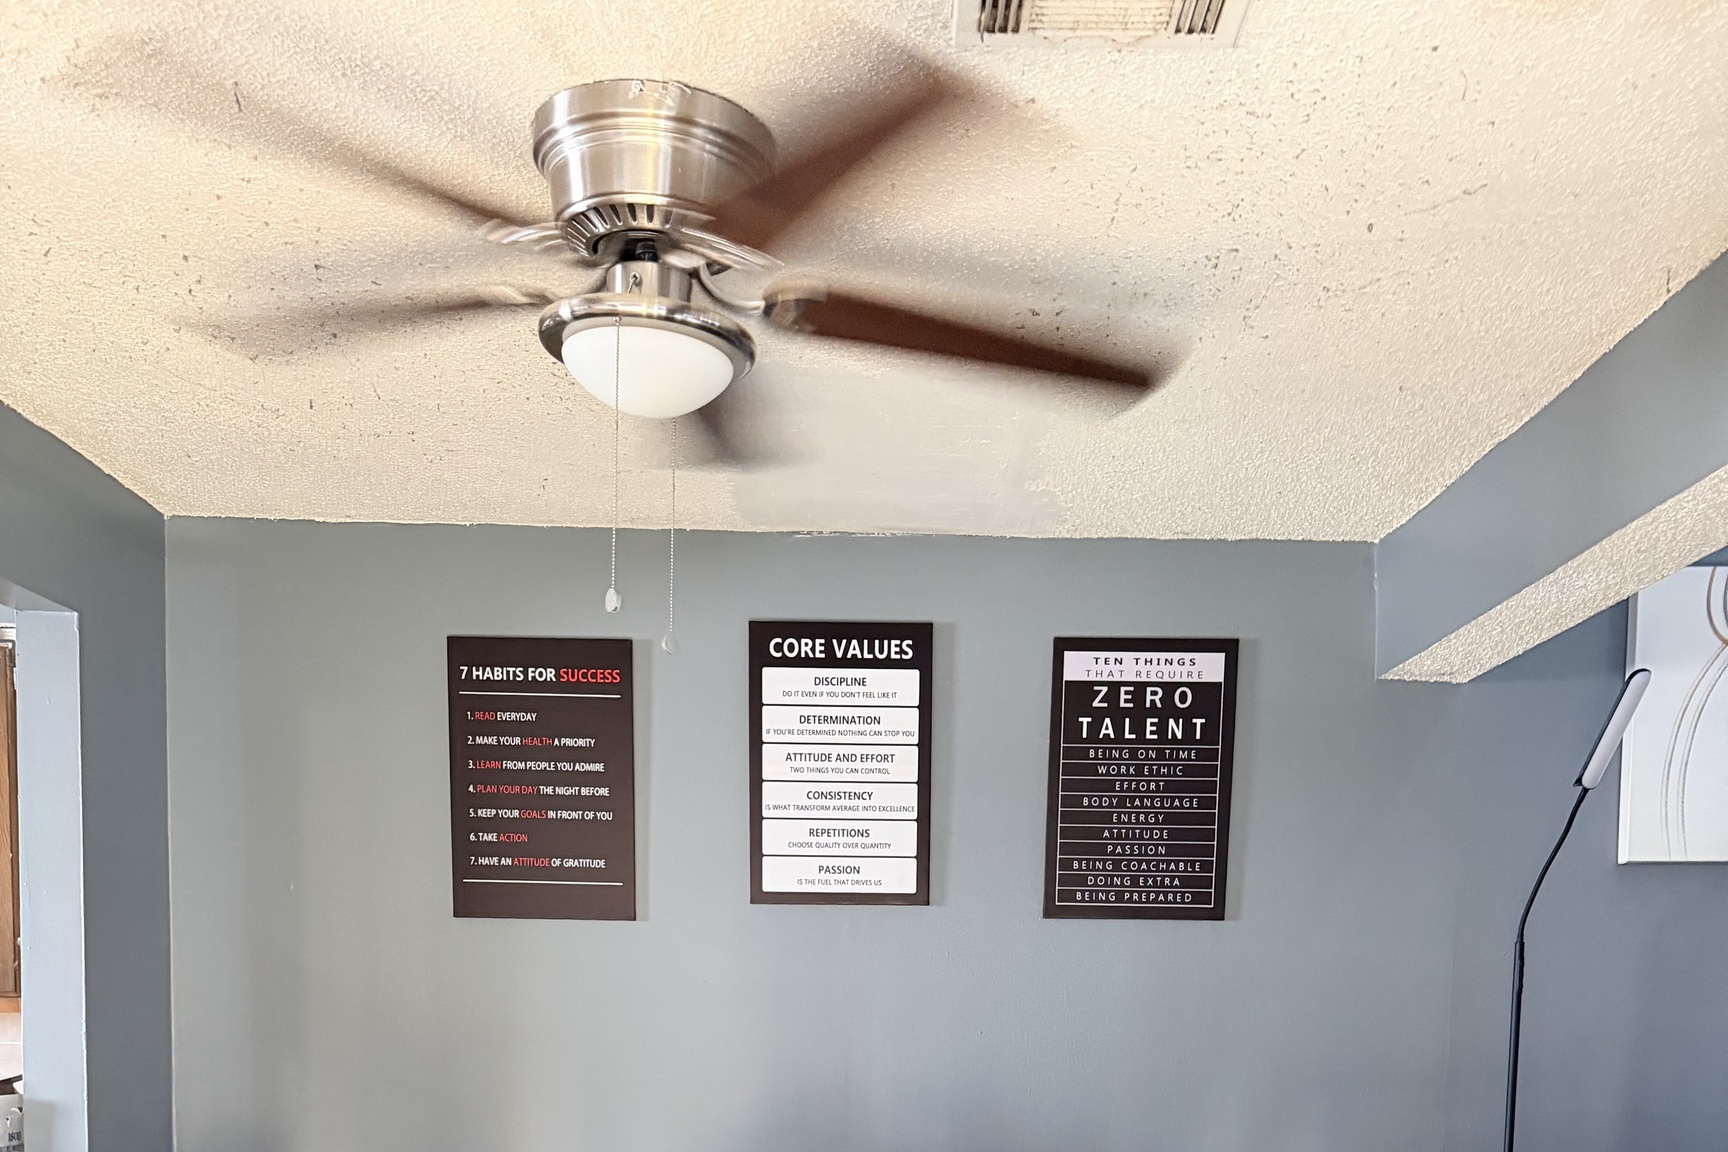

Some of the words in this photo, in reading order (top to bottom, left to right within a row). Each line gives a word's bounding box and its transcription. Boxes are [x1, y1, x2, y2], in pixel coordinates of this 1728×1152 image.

[769, 638, 825, 658] CORE
[832, 640, 913, 660] VALUES
[1093, 657, 1123, 666] TEN
[1134, 658, 1196, 666] THINGS
[460, 667, 468, 680] 7
[472, 668, 524, 681] HABITS
[528, 668, 556, 681] FOR
[560, 669, 620, 683] SUCCESS
[1086, 669, 1124, 678] THAT
[1136, 670, 1204, 680] REQUIRE
[814, 677, 867, 687] DISCIPLINE
[1092, 686, 1192, 708] ZERO
[467, 712, 473, 720] 1.
[475, 712, 495, 720] READ
[497, 712, 536, 721] EVERYDAY
[800, 715, 881, 725] DETERMINATION
[1079, 717, 1205, 740] TALENT
[468, 736, 474, 745] 2.
[476, 736, 497, 745] MAKE
[500, 736, 521, 746] YOUR
[523, 737, 552, 746] HEALTH
[554, 738, 560, 747] A
[561, 738, 595, 747] PRIORITY
[785, 753, 832, 763] ATTITUDE
[835, 753, 857, 763] AND
[861, 754, 895, 763] EFFORT
[1090, 749, 1130, 758] BEING
[1138, 750, 1156, 759] ON
[1165, 750, 1197, 760] TIME
[468, 760, 475, 769] 3.
[477, 760, 501, 769] LEARN
[503, 761, 525, 770] FROM
[527, 762, 555, 771] PEOPLE
[557, 762, 573, 771] YOU
[575, 762, 604, 772] ADMIRE
[790, 766, 805, 774] TWO
[1098, 766, 1136, 774] WORK
[1144, 766, 1183, 775] ETHIC
[468, 785, 476, 793] 4.
[477, 785, 497, 793] PLAN
[499, 786, 520, 794] YOUR
[522, 786, 538, 795] DAY
[539, 786, 554, 795] THE
[556, 786, 579, 796] NIGHT
[581, 787, 610, 796] BEFORE
[1116, 782, 1165, 791] EFFORT
[807, 791, 873, 801] CONSISTENCY
[1083, 797, 1119, 806] BODY
[1127, 798, 1198, 808] LANGUAGE
[470, 809, 476, 817] 5.
[478, 809, 496, 818] KEEP
[498, 810, 519, 819] YOUR
[521, 810, 546, 819] GOALS
[548, 810, 556, 819] IN
[558, 811, 582, 820] FRONT
[584, 811, 595, 820] OF
[596, 811, 613, 820] YOU
[1113, 814, 1165, 823] ENERGY
[470, 833, 477, 841] 6.
[478, 833, 497, 841] TAKE
[499, 834, 528, 842] ACTION
[809, 828, 870, 838] REPETITIONS
[1103, 830, 1168, 839] ATTITUDE
[816, 842, 841, 850] QUALITY
[1108, 845, 1166, 854] PASSION
[470, 857, 477, 865] 7.
[479, 857, 499, 866] HAVE
[500, 858, 512, 866] AN
[514, 858, 549, 867] ATTITUDE
[552, 858, 561, 867] OF
[563, 858, 606, 868] GRATITUDE
[1074, 861, 1113, 870] BEING
[1122, 862, 1201, 871] COACHABLE
[819, 865, 860, 875] PASSION
[1088, 877, 1131, 886] DOING
[1140, 877, 1180, 886] EXTRA
[1076, 892, 1116, 901] BEING
[1124, 893, 1192, 902] PREPARED
